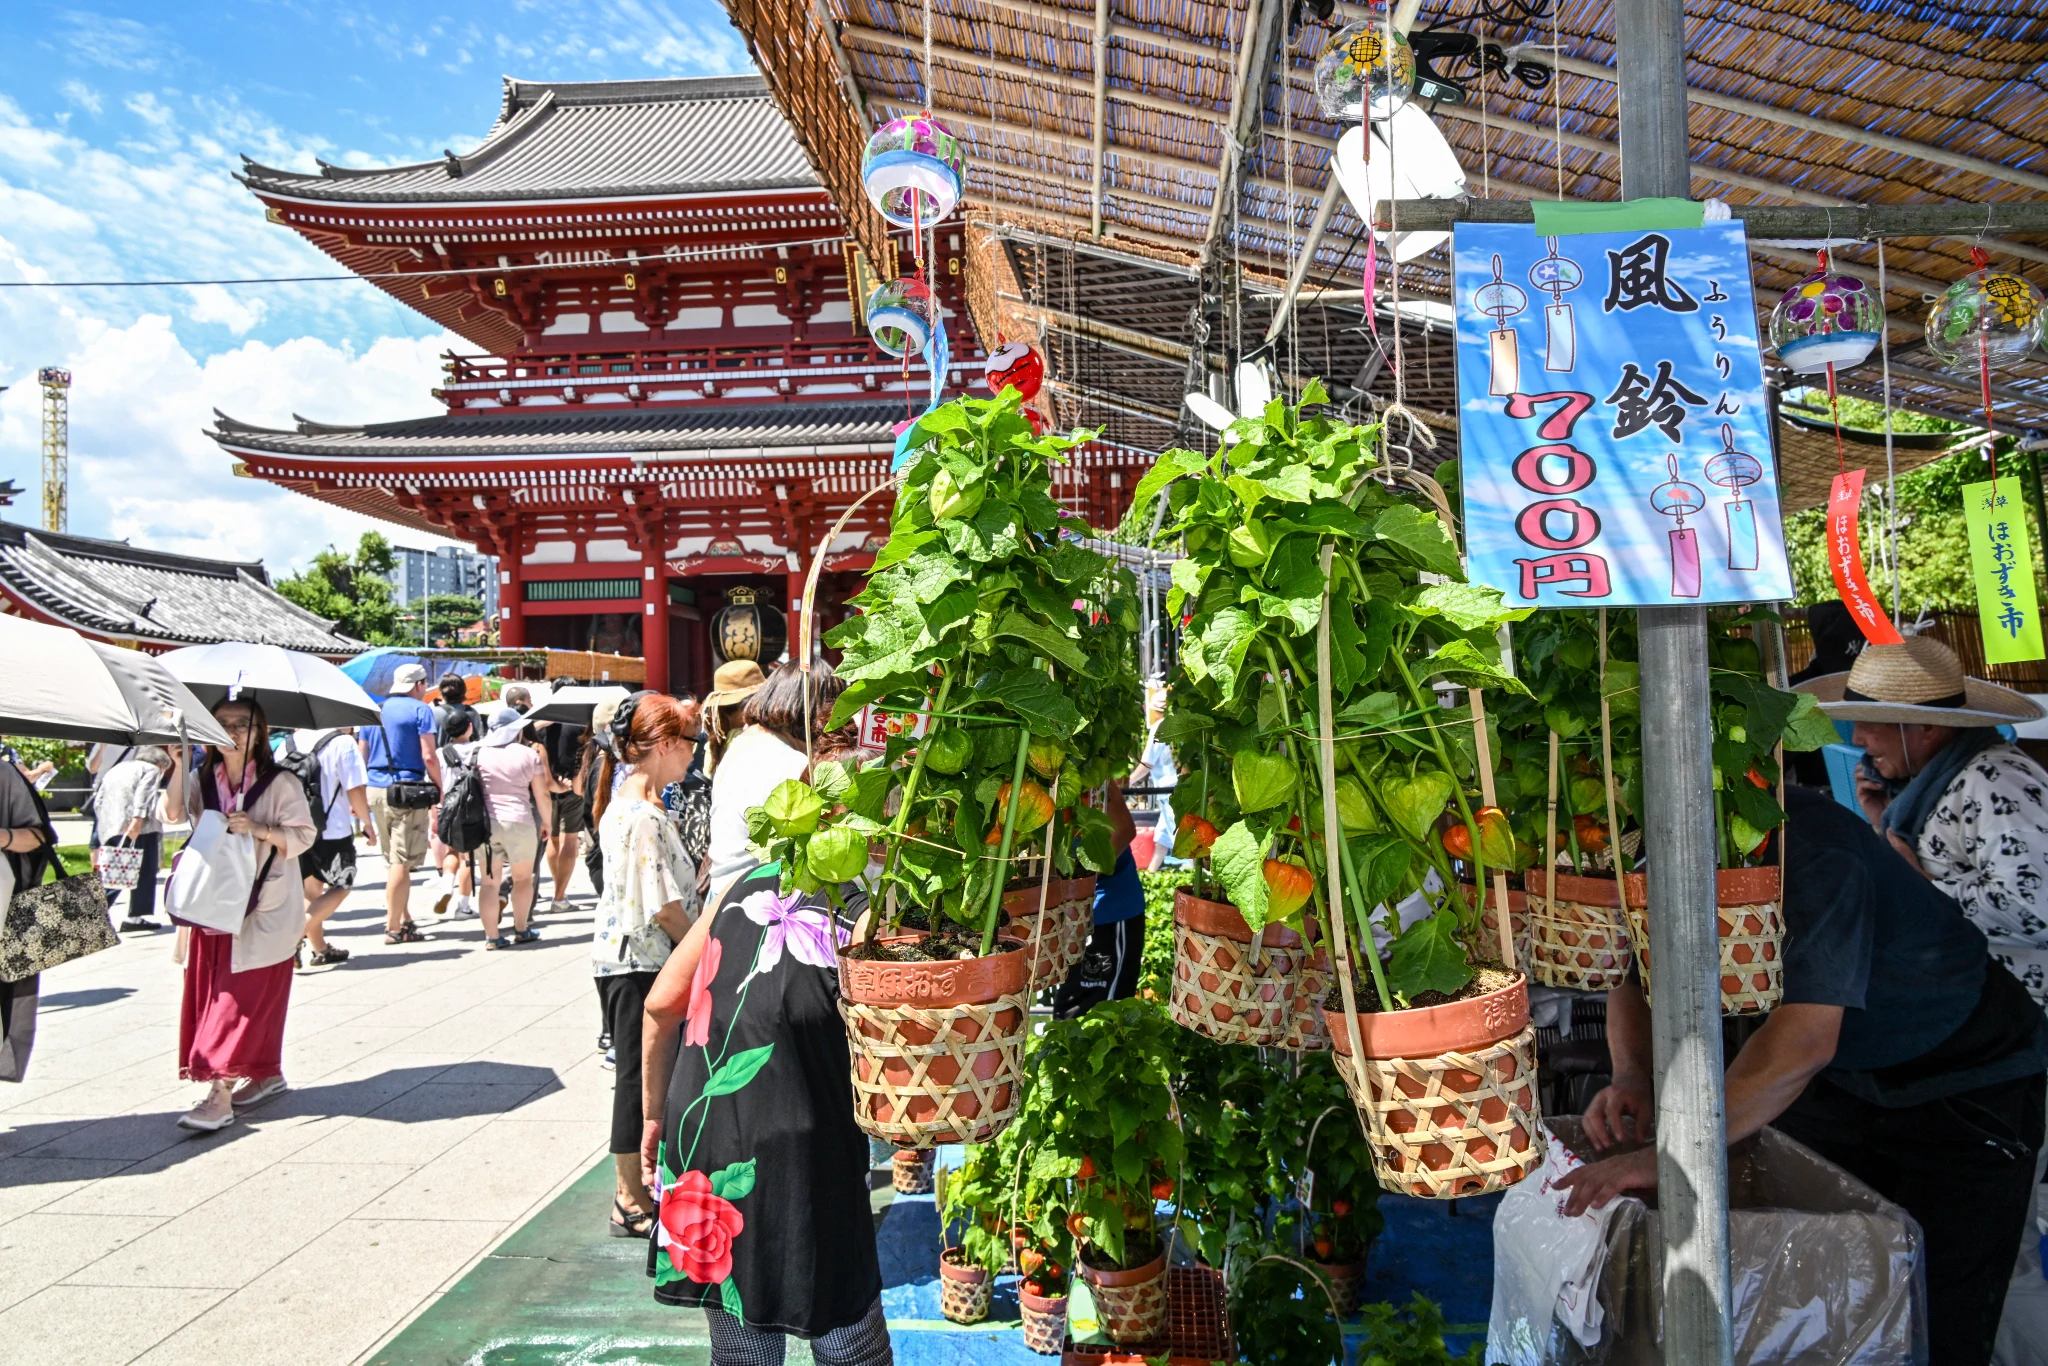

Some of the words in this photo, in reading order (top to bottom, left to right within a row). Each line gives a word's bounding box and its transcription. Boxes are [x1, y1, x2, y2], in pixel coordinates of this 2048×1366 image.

[1604, 233, 1709, 444] 風鈴
[1704, 280, 1740, 415] ふうりん
[1503, 390, 1613, 600] 700円
[1835, 515, 1876, 627] ほおずき市
[1988, 521, 2025, 639] ほおずき市
